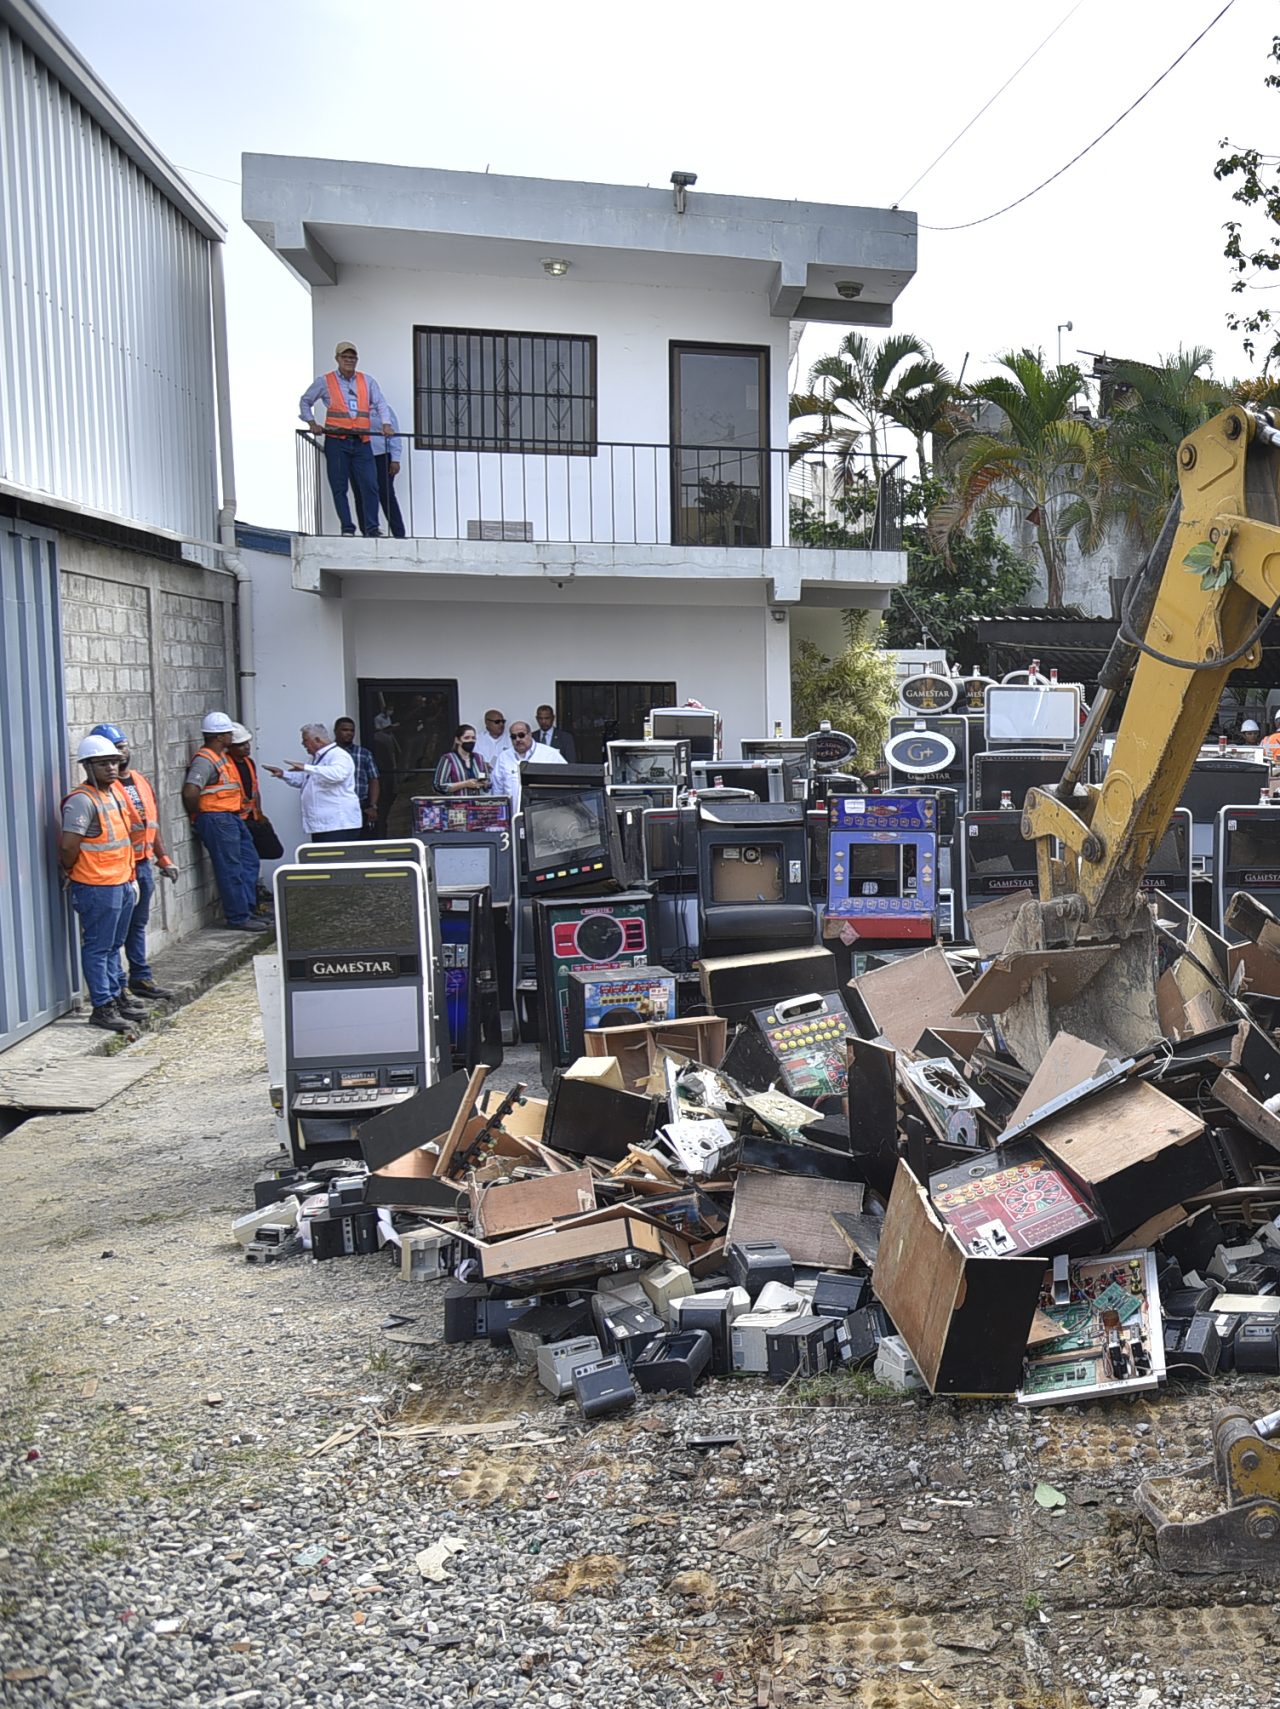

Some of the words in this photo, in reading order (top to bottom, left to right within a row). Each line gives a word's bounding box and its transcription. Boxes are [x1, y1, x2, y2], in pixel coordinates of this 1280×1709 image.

[499, 832, 510, 852] 3
[988, 879, 1034, 888] GAMESTAR
[313, 961, 392, 975] GAMESTAR
